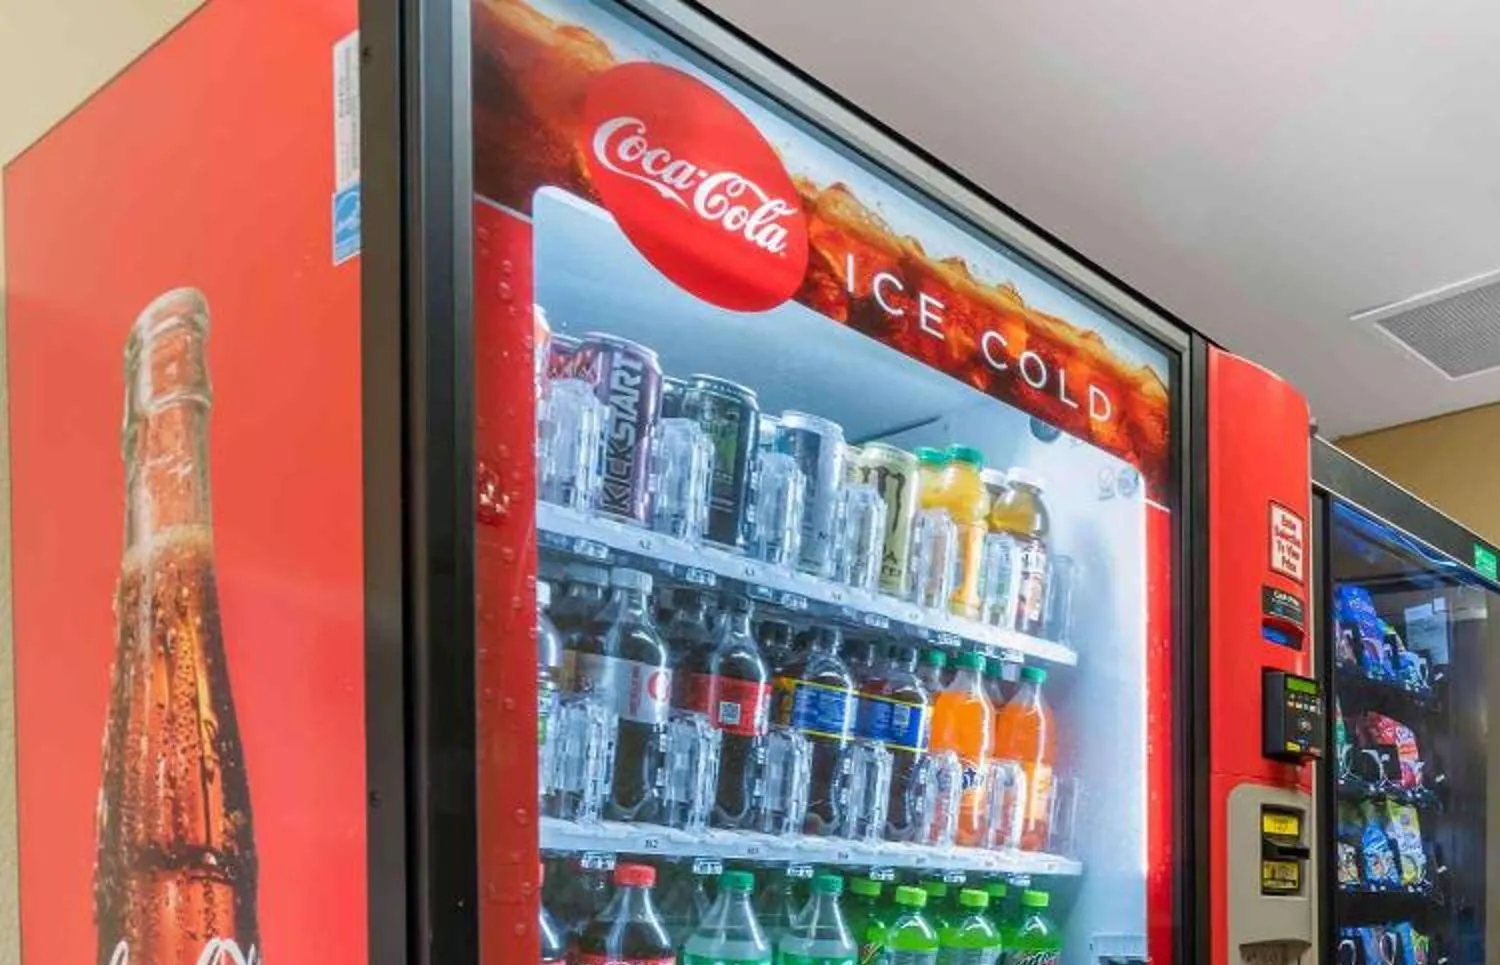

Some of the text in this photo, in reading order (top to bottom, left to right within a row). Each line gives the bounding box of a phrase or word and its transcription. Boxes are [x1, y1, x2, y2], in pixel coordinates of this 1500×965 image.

[592, 115, 788, 258] Coca-Cola
[844, 254, 1112, 423] ICE COLD
[600, 350, 645, 513] KICKSTART
